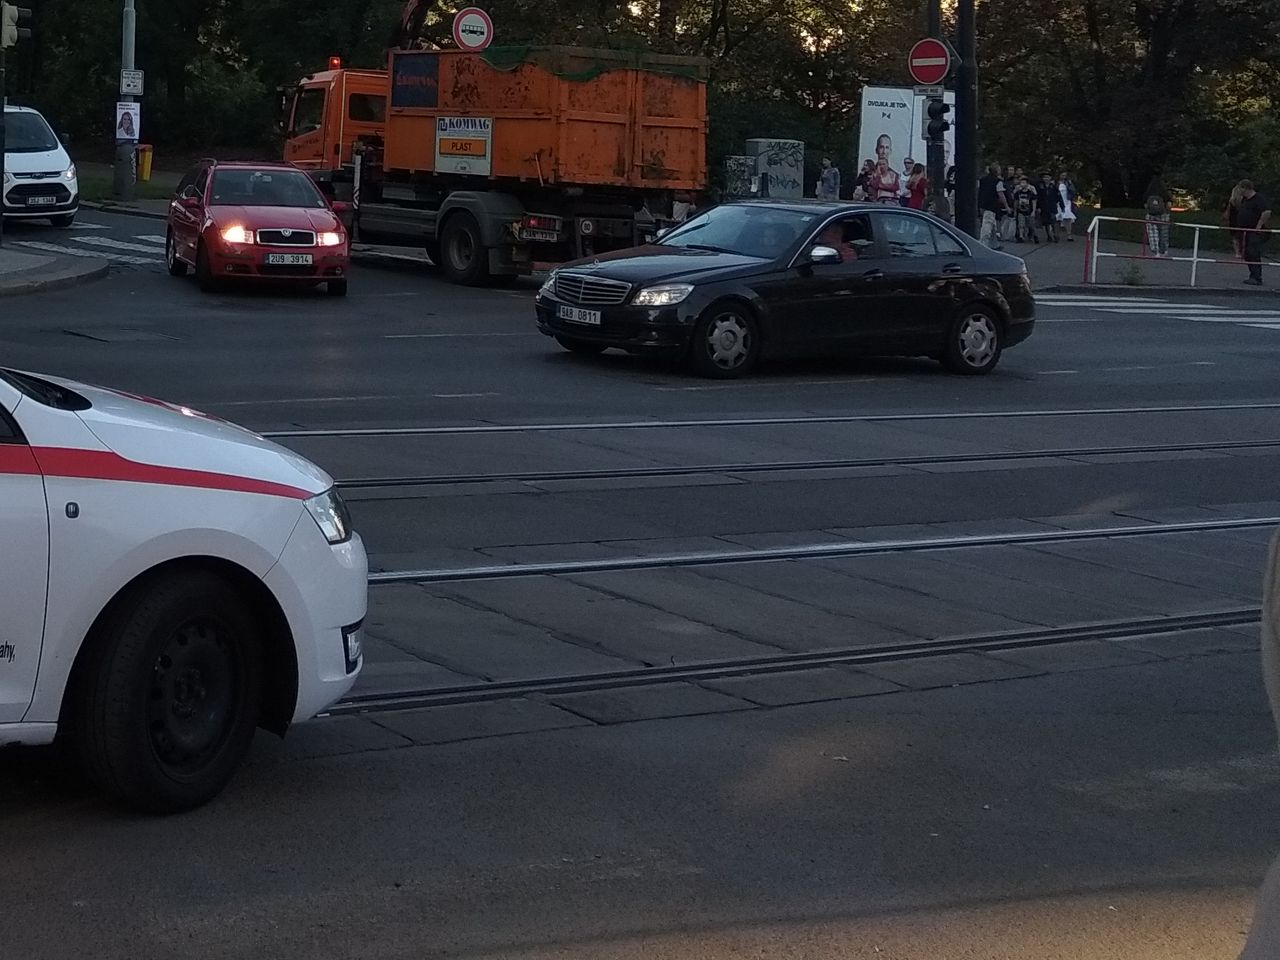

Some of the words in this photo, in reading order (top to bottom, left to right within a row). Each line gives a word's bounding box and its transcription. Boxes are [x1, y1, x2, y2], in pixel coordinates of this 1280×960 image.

[448, 118, 490, 130] KOMWAG
[451, 142, 473, 152] PLAST
[271, 254, 285, 263] 2U9
[290, 255, 309, 264] 3914
[578, 310, 597, 323] 0811
